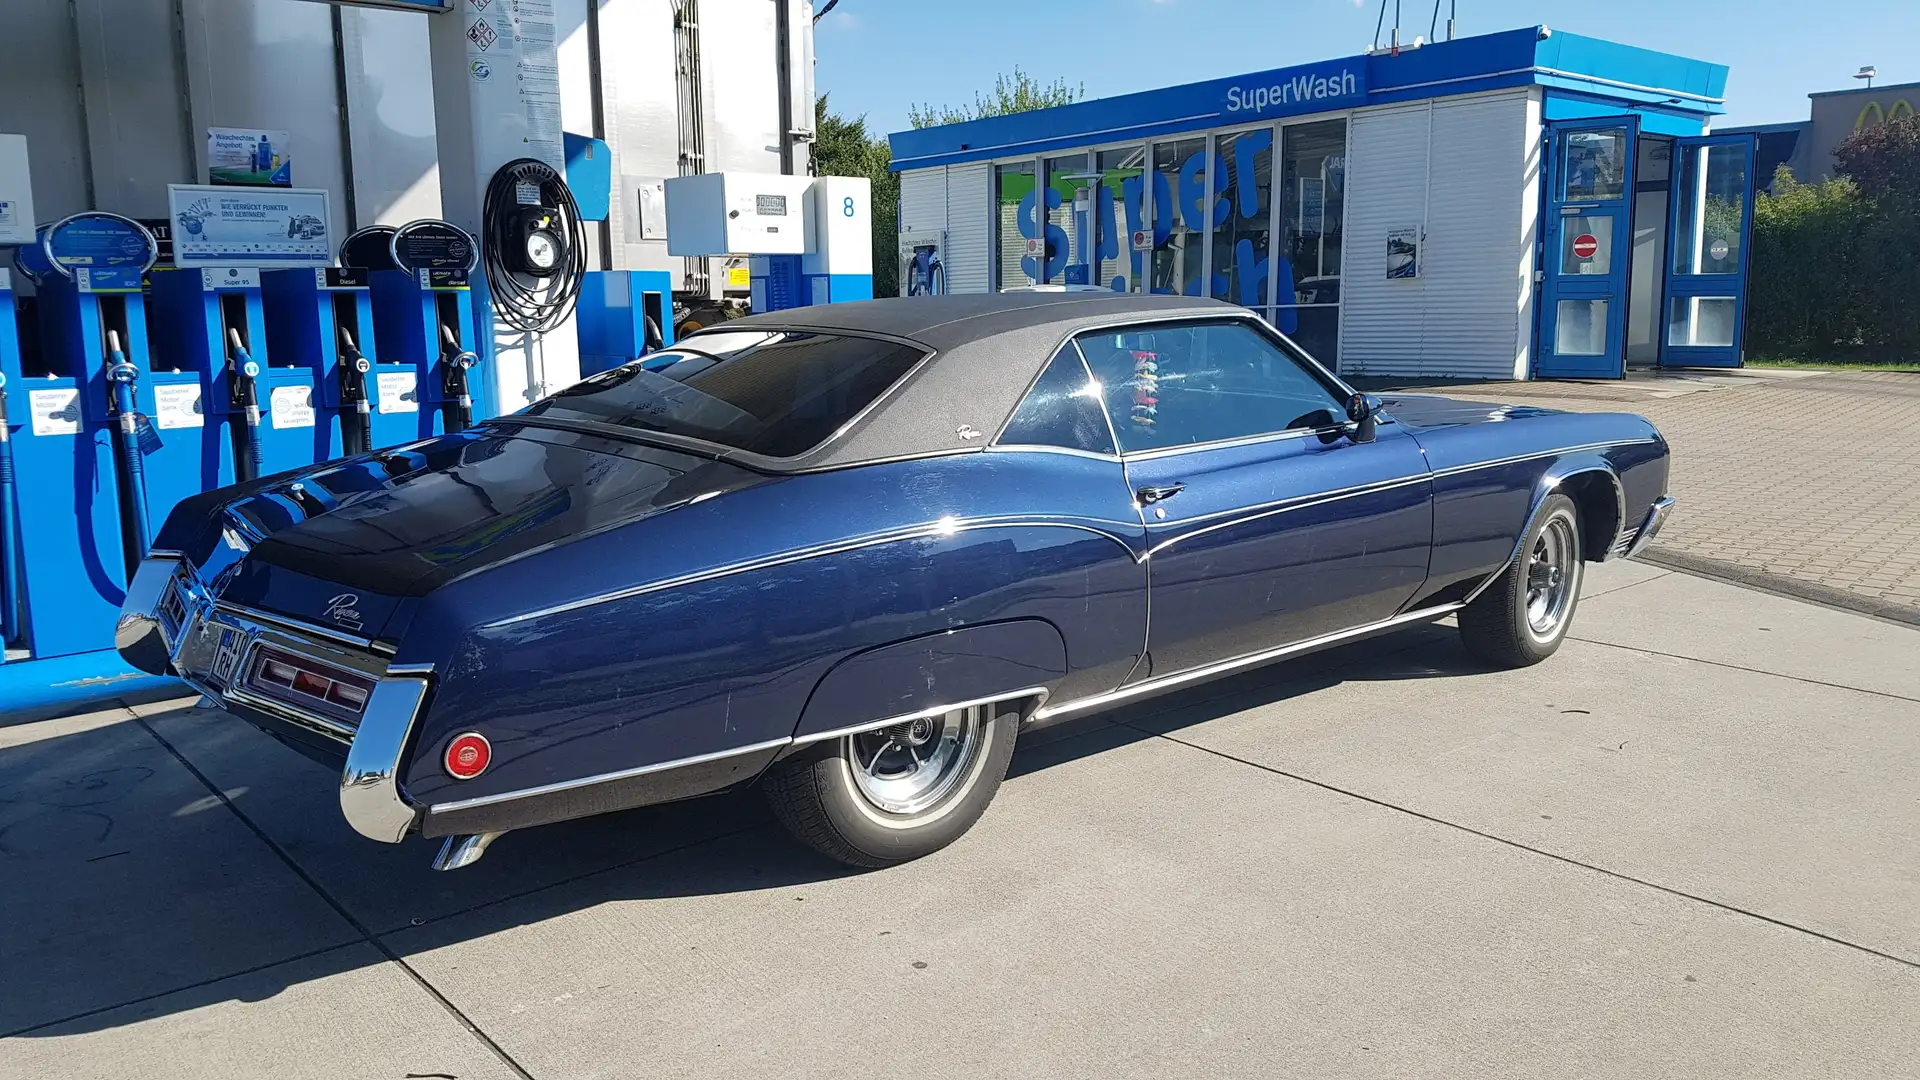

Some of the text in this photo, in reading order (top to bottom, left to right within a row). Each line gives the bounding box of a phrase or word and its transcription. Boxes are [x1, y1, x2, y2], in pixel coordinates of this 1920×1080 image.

[1226, 68, 1356, 113] SuperWash
[221, 210, 234, 218] UND
[843, 196, 854, 217] 8
[1017, 129, 1273, 281] Super
